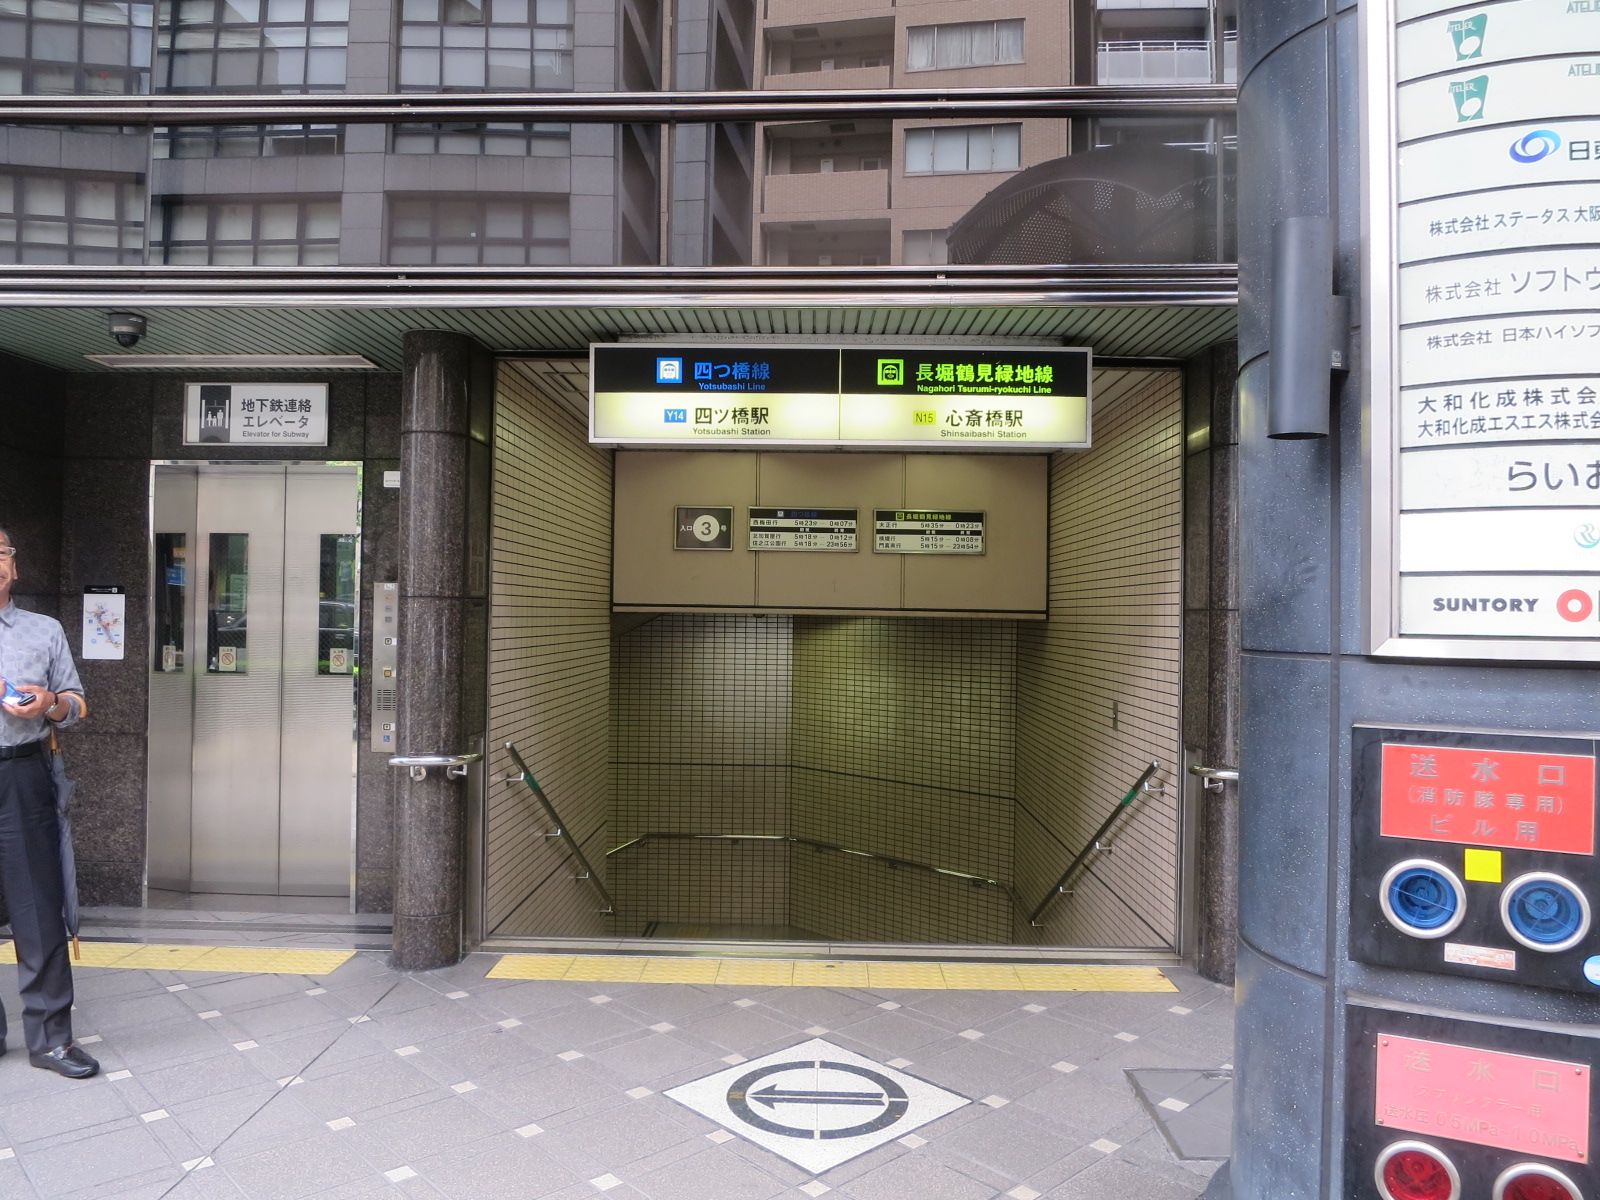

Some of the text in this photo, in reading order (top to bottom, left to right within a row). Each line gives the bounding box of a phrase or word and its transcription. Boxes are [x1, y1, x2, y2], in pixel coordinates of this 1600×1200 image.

[1567, 0, 1600, 14] ATELI
[1568, 64, 1600, 76] ATELI
[694, 362, 770, 380] 四つ橋線
[916, 364, 1053, 383] 長堀鶴見緑地線
[917, 385, 955, 394] Nagahori
[958, 385, 1031, 394] Tsurumi-ryokuchi
[241, 399, 312, 412] 地下鉄連絡
[666, 410, 684, 420] Y14
[695, 407, 769, 424] 四ツ橋駅
[916, 414, 933, 422] N15
[945, 410, 1023, 427] 心斎橋駅
[243, 416, 309, 428] エレベータ
[940, 430, 995, 438] Shinsaibashi
[700, 522, 712, 535] 3
[1433, 598, 1539, 612] SUNTORY
